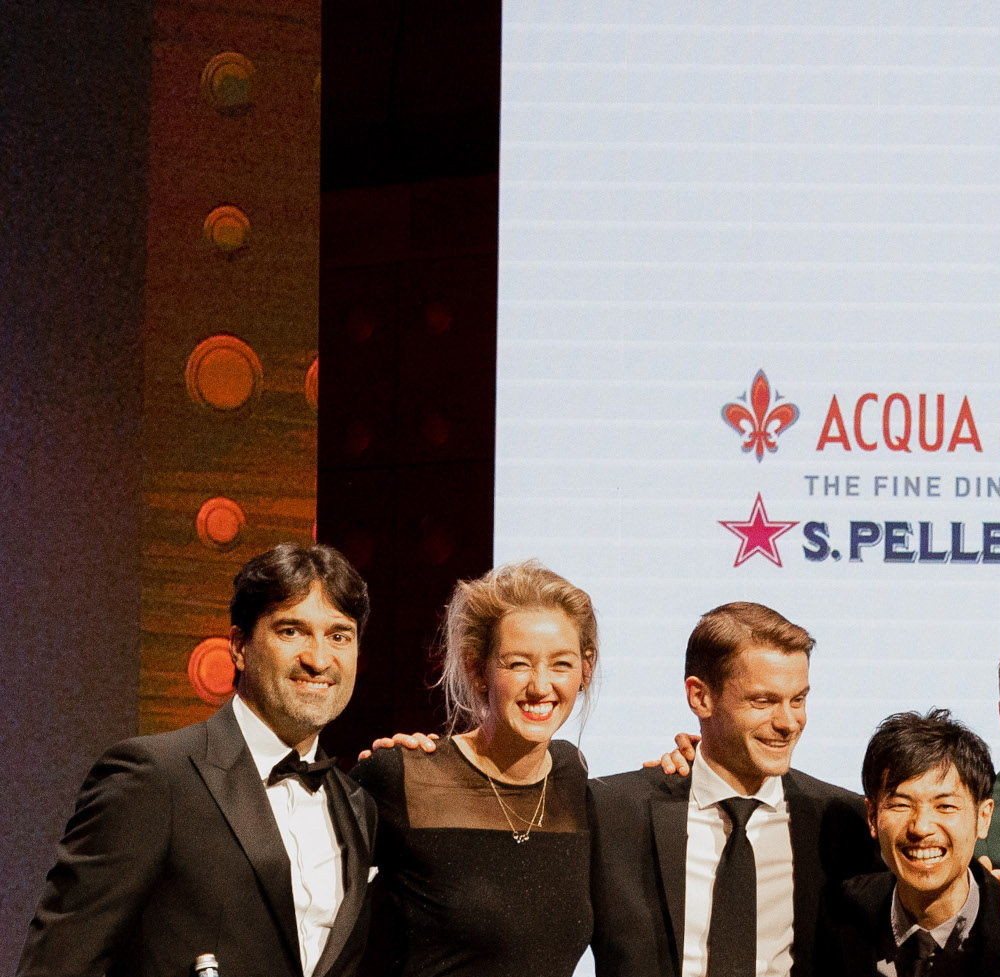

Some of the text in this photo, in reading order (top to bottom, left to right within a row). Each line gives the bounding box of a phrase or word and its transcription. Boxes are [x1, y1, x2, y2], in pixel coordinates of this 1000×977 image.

[815, 392, 984, 454] ACQUA
[803, 475, 860, 497] THE
[874, 475, 941, 498] FINE
